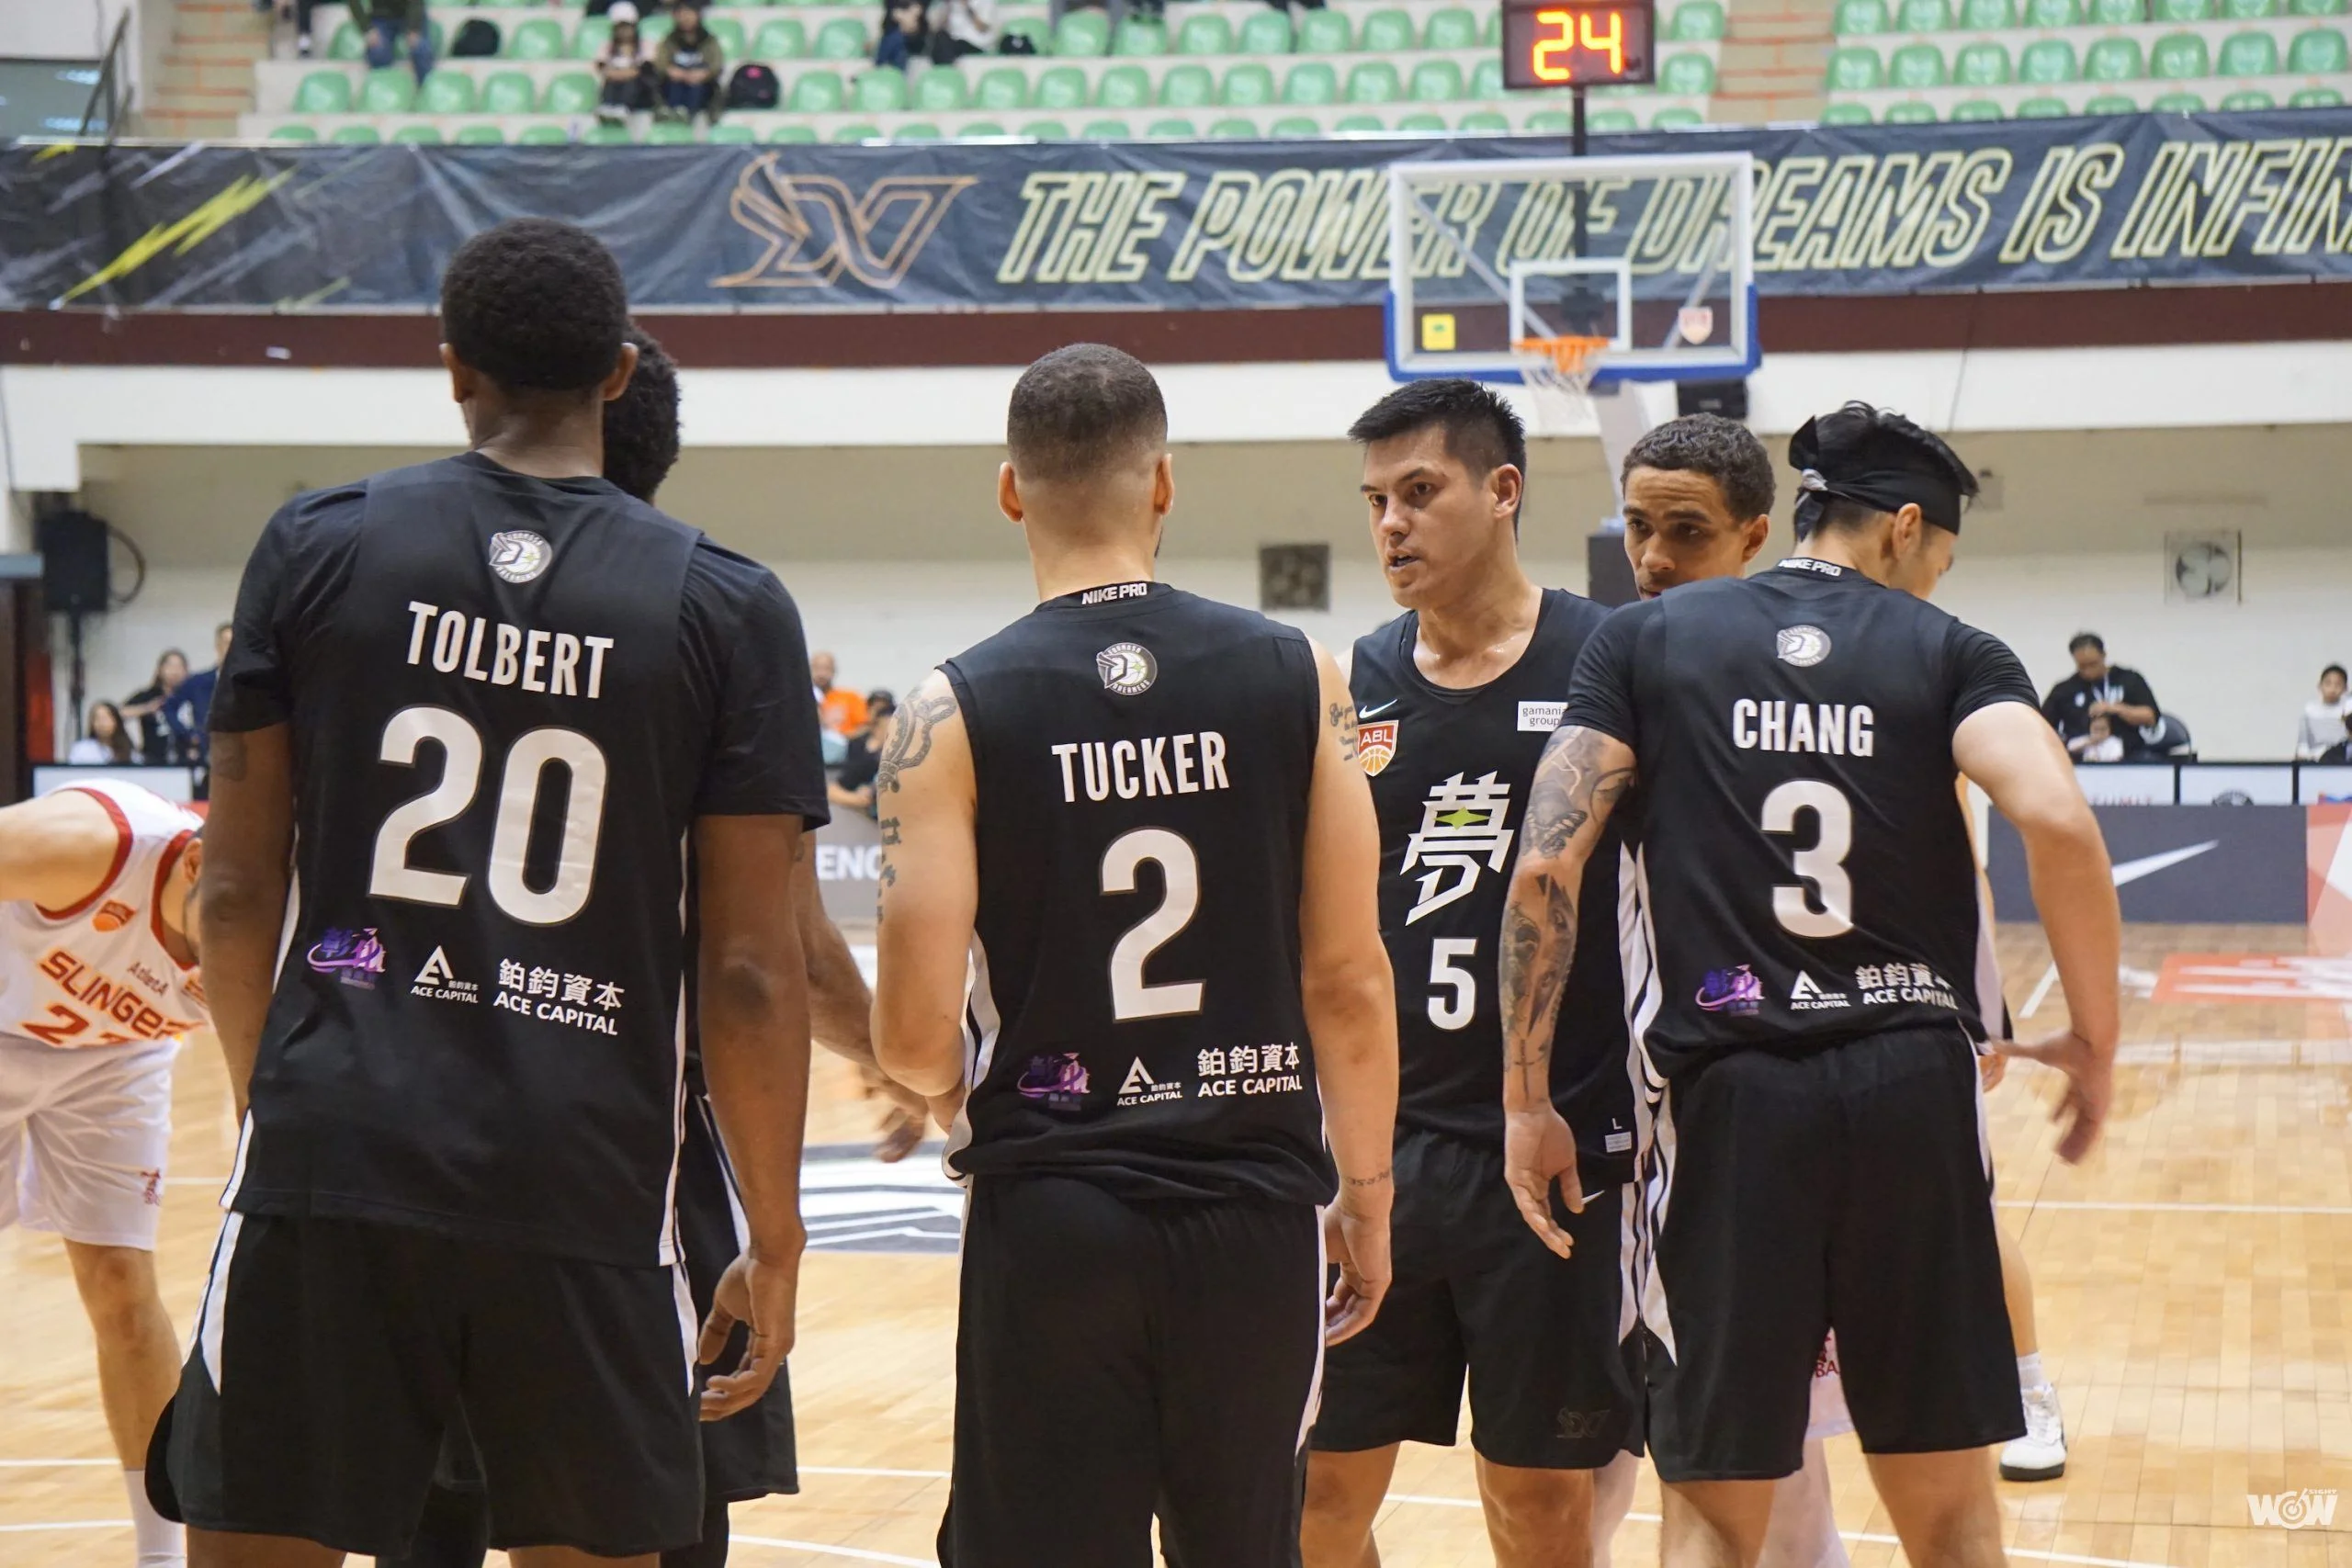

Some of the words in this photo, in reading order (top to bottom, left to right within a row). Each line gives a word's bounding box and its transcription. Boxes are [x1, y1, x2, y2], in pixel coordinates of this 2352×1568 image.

[1532, 10, 1622, 81] 24
[996, 171, 1188, 283] THE
[1167, 168, 1503, 283] POWER
[1625, 149, 2013, 275] DREAMS
[1998, 144, 2124, 265] IS
[1812, 561, 1842, 577] PRO
[1082, 586, 1117, 605] NIKE
[1119, 582, 1148, 599] PRO
[407, 601, 614, 699] TOLBERT
[1522, 706, 1567, 717] gamani
[1733, 698, 1873, 757] CHANG
[1361, 728, 1393, 747] ABL
[1051, 731, 1229, 803] TUCKER
[368, 704, 609, 926] 20
[1760, 779, 1855, 939] 3
[1100, 827, 1206, 1022] 2
[411, 985, 434, 997] ACE
[435, 989, 479, 1004] CAPITAL
[498, 958, 625, 1010] 鉑鈞資本
[1427, 938, 1480, 1031] 5
[1862, 989, 1898, 1005] ACE
[1900, 988, 1959, 1010] CAPITAL
[493, 991, 532, 1015] ACE
[537, 1003, 618, 1036] CAPITAL
[1197, 1042, 1300, 1077] 鉑鈞資本
[1116, 1097, 1137, 1106] ACE
[1139, 1091, 1183, 1103] CAPITAL
[1197, 1079, 1237, 1098] ACE
[1242, 1075, 1303, 1095] CAPITAL
[1611, 1117, 1623, 1130] L
